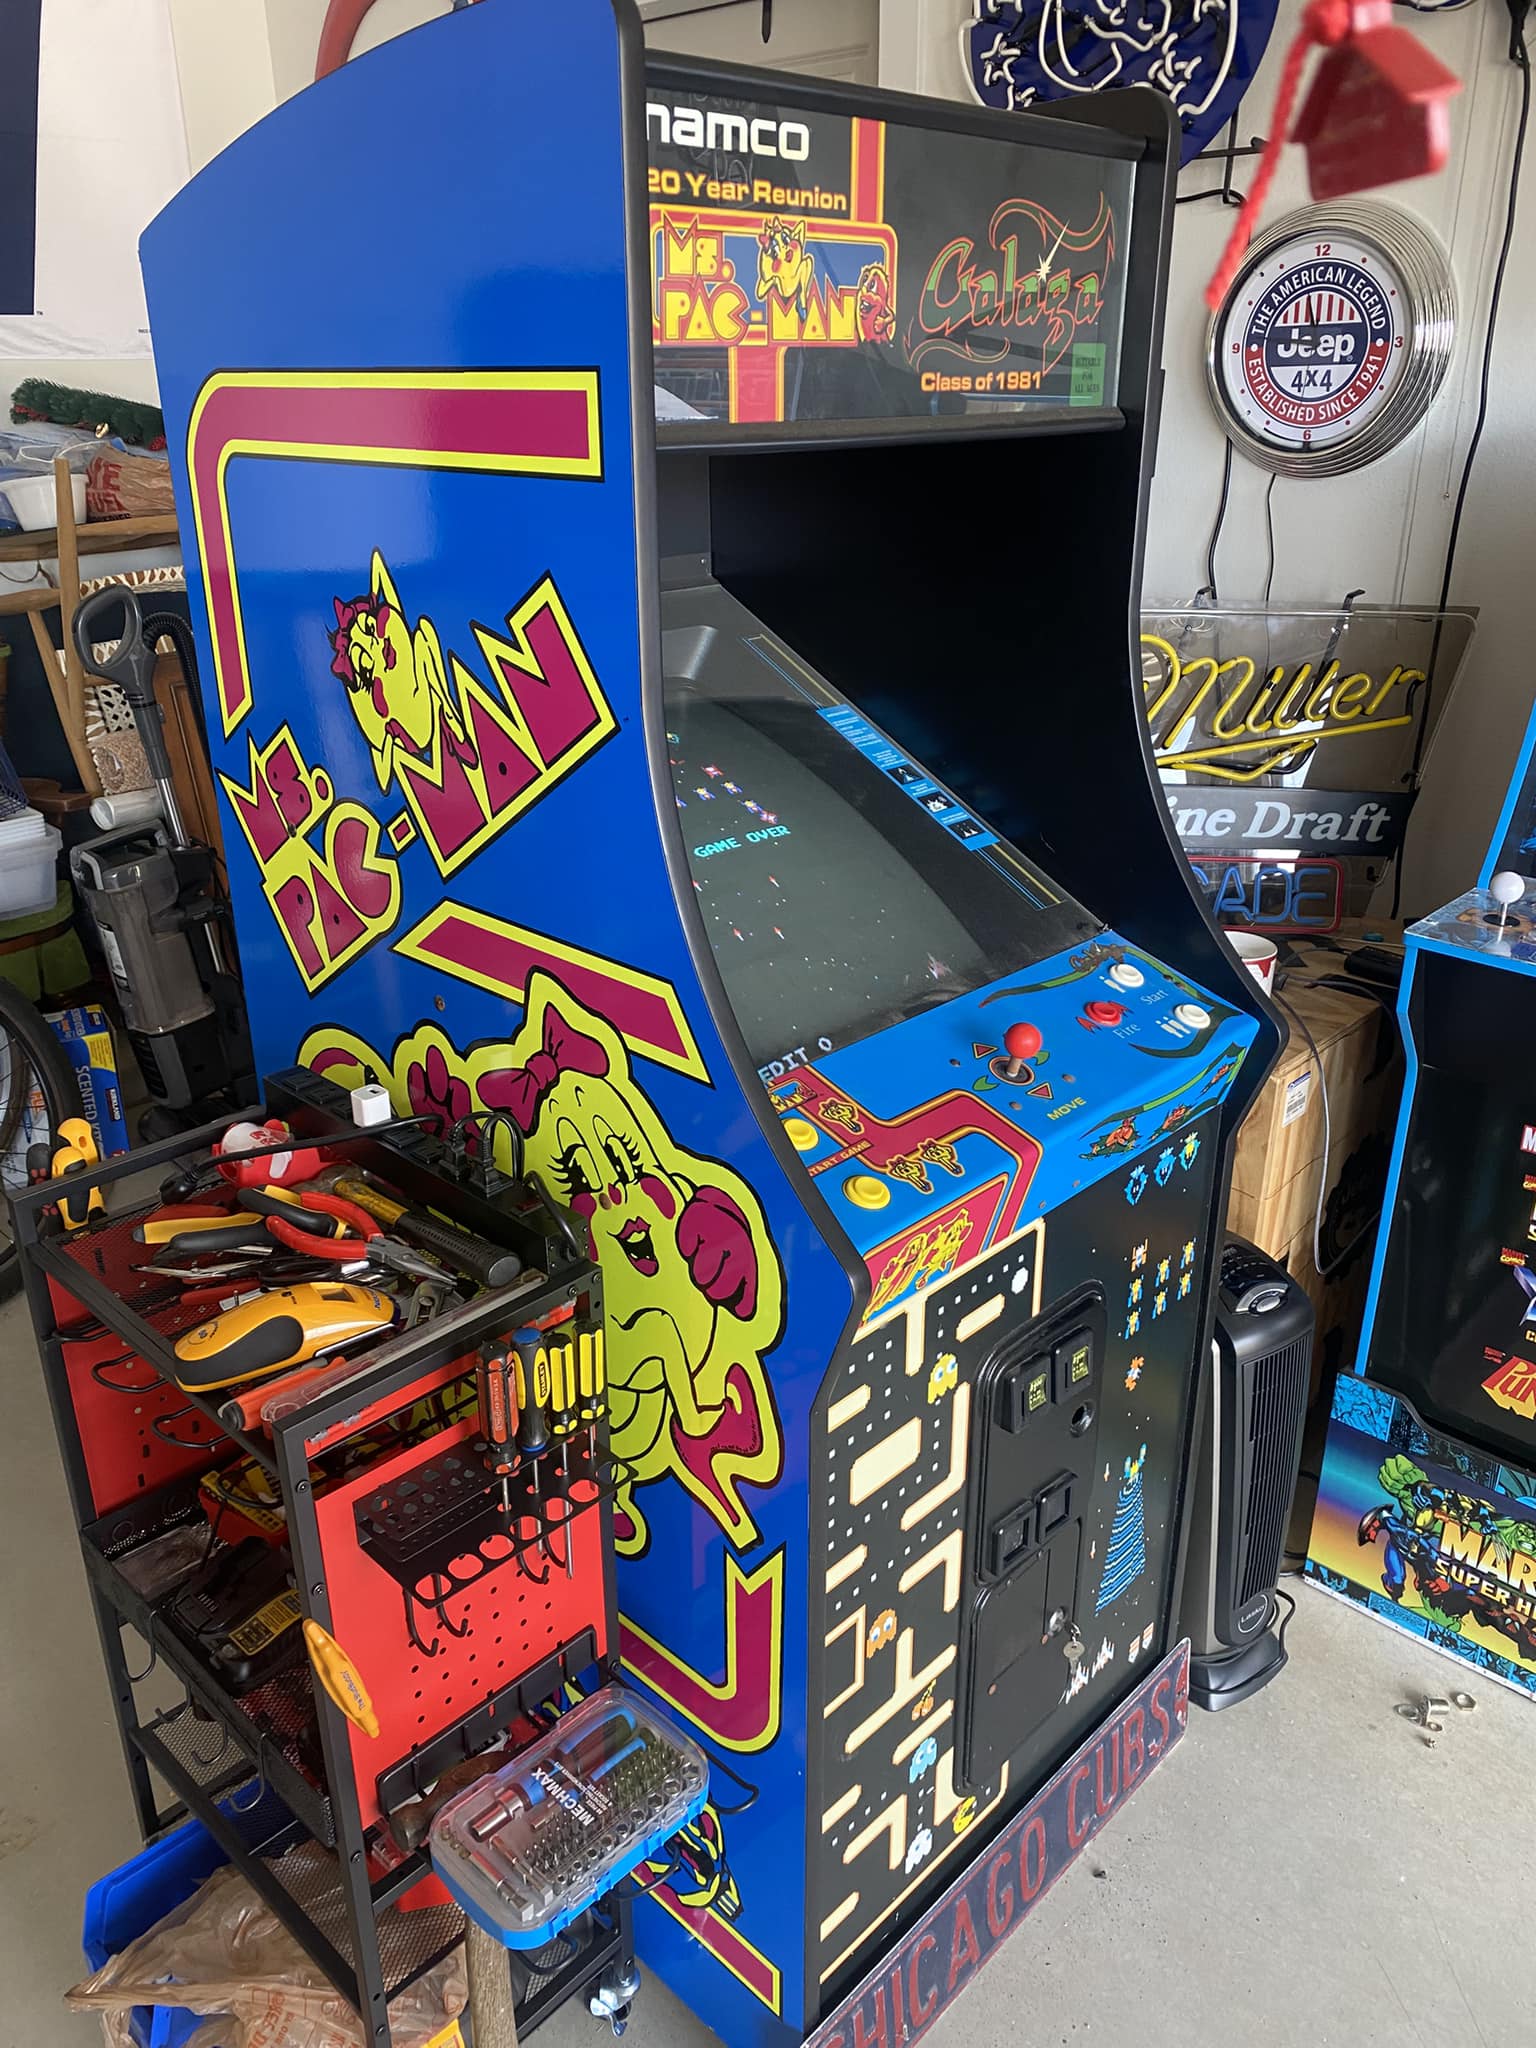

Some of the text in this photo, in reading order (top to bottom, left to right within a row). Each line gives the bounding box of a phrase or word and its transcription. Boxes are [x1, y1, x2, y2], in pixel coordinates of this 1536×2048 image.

[646, 102, 810, 161] namco
[684, 172, 749, 203] Year
[753, 179, 847, 211] Reunion
[1315, 244, 1331, 256] 12
[663, 282, 857, 343] PAC-MAN
[919, 233, 1103, 375] Galaga
[1252, 267, 1386, 335] THE AMERICAN LEGEND
[1232, 343, 1240, 354] 9
[1277, 328, 1355, 363] Jeep
[1395, 336, 1403, 348] 3
[921, 371, 1041, 391] Class of 1981
[1249, 355, 1382, 422] ESTABLISHED SINCE 1941
[1303, 429, 1311, 440] 6
[260, 569, 621, 999] PAC-MAN
[693, 825, 791, 857] GAME OVER
[1242, 800, 1391, 843] Draft
[1140, 988, 1168, 1005] Start
[1112, 1023, 1141, 1039] Fire
[76, 1065, 98, 1121] SCENTED
[1047, 1096, 1087, 1121] MOVE
[840, 1139, 873, 1158] GAME
[1435, 1558, 1512, 1605] SUPER
[1066, 1677, 1171, 1849] CUBS
[531, 1767, 595, 1826] MECHMAX
